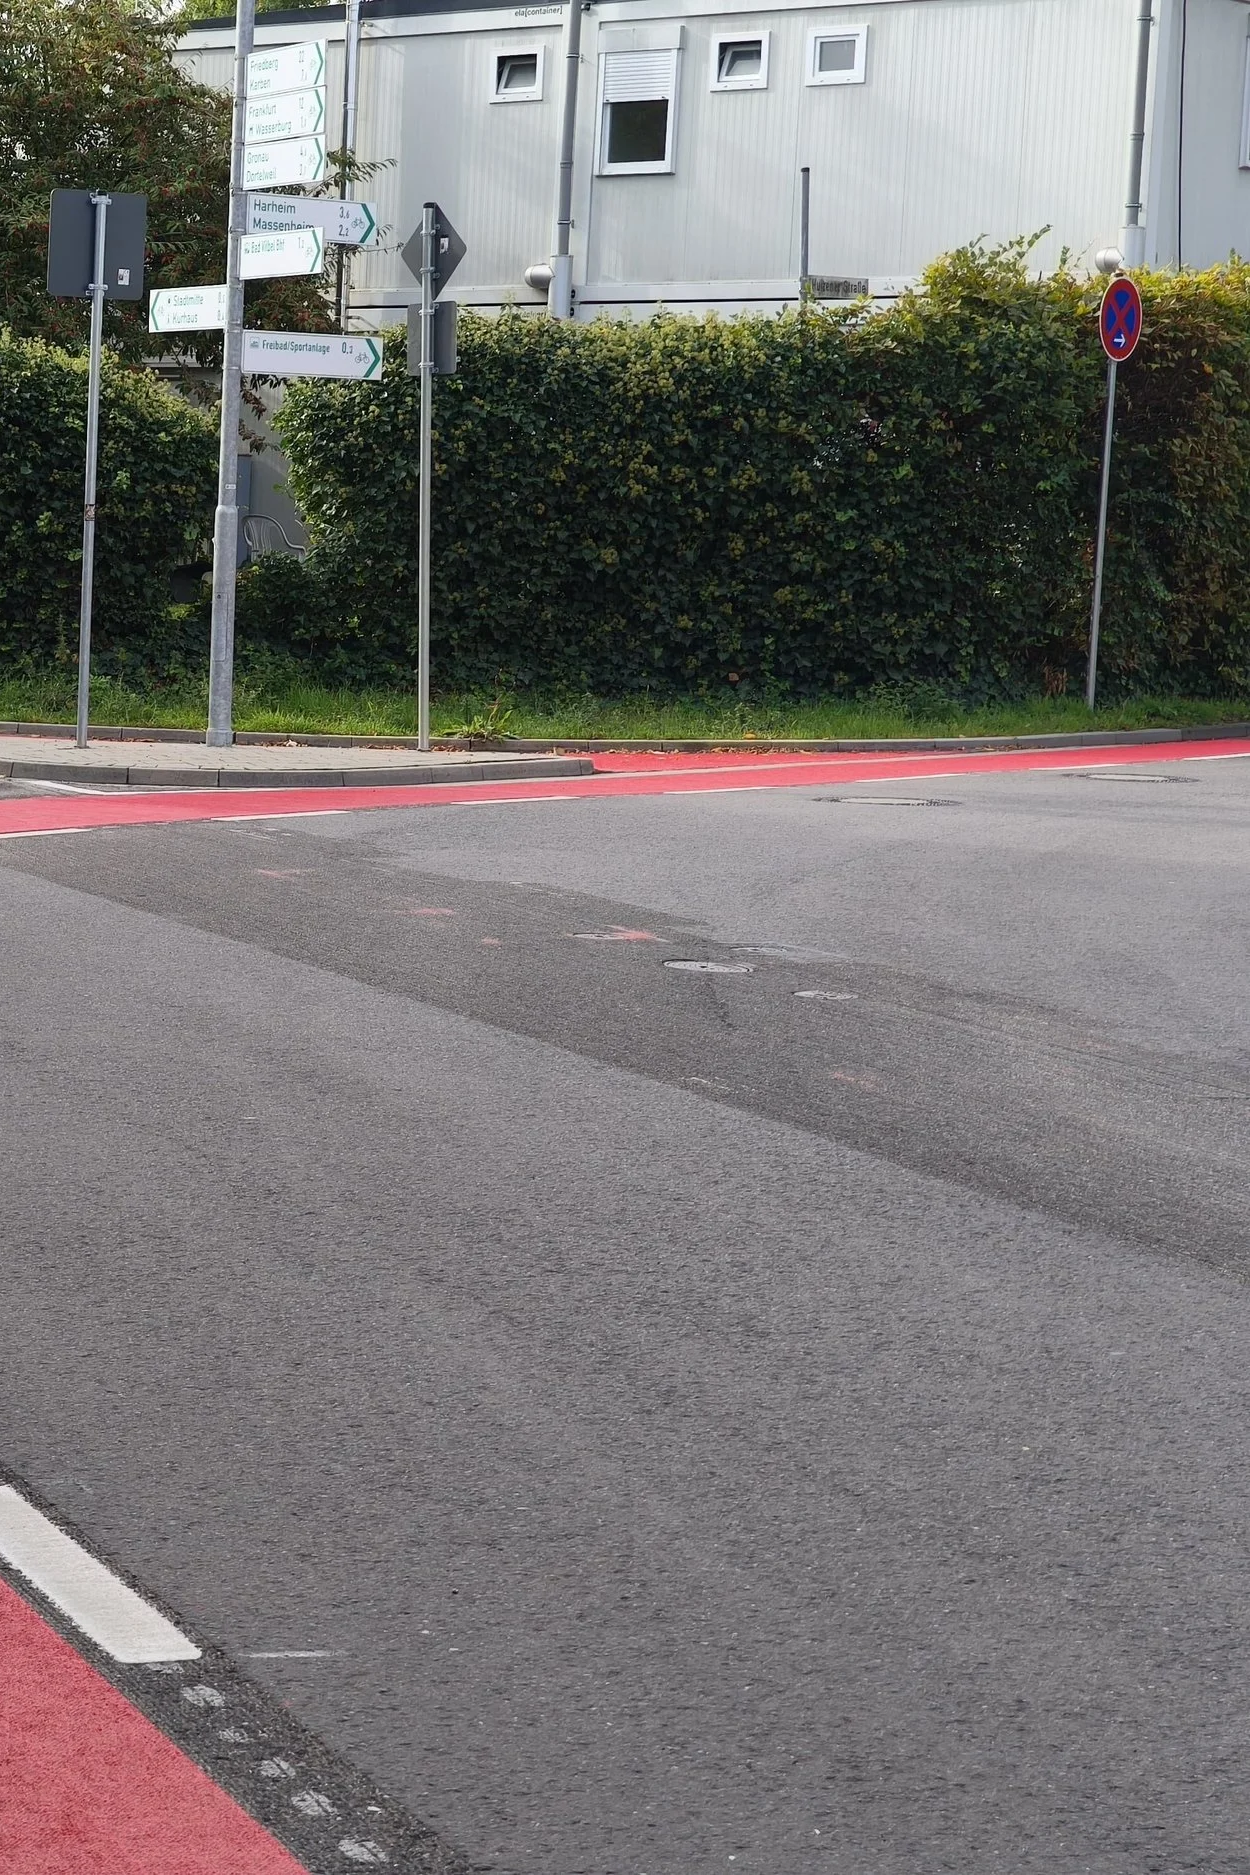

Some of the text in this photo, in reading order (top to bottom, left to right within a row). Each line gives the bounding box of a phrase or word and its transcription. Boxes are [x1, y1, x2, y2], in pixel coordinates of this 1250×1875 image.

[250, 58, 278, 72] Friedberg
[250, 79, 271, 91] Karben
[249, 104, 277, 118] Frankfurt
[256, 121, 291, 135] Wasserburg
[247, 151, 270, 164] Gronau
[246, 167, 277, 182] Dortelweil
[253, 199, 296, 214] Harheim
[843, 280, 866, 294] Straße
[173, 294, 204, 306] Stadtmitte
[173, 312, 198, 324] Kurhaus
[262, 339, 330, 355] Freibad/Sportanlage
